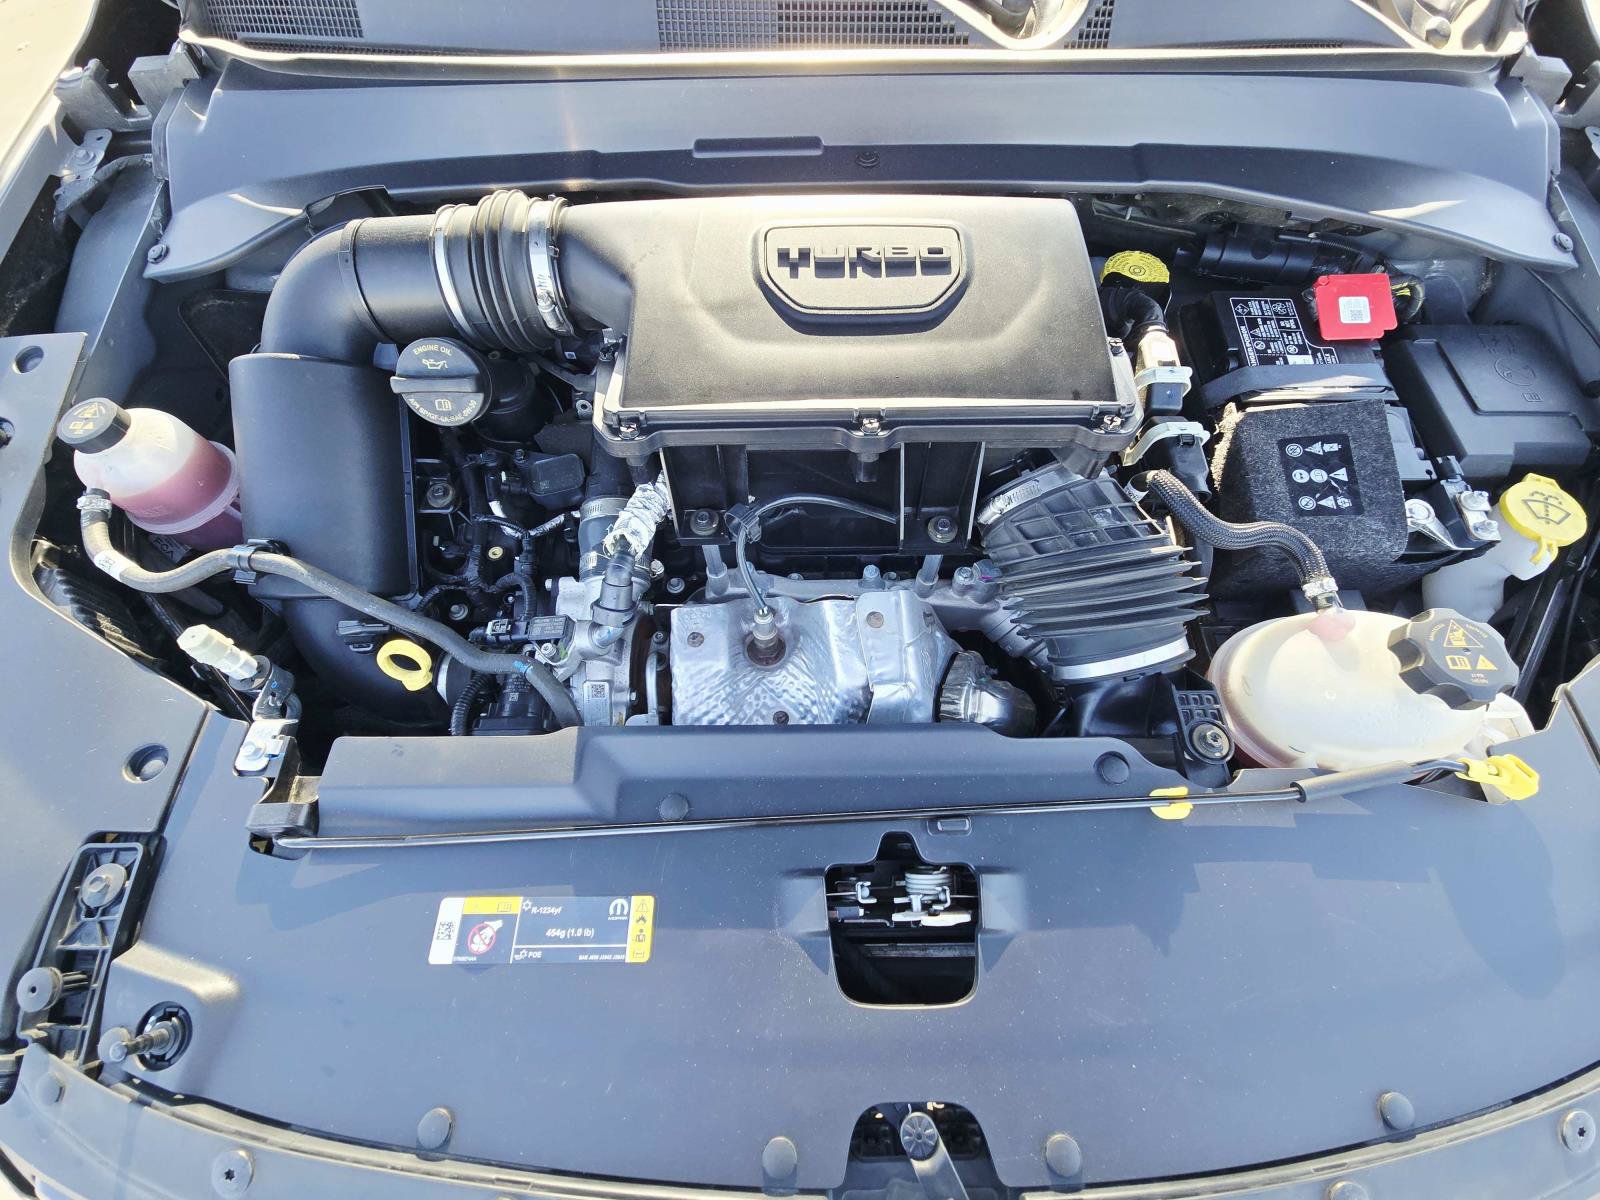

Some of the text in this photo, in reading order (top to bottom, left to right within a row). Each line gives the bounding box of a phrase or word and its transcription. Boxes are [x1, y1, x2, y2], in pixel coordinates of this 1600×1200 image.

[776, 243, 952, 279] TURBO
[413, 344, 453, 356] ENGINE OIL
[545, 928, 566, 939] 454g
